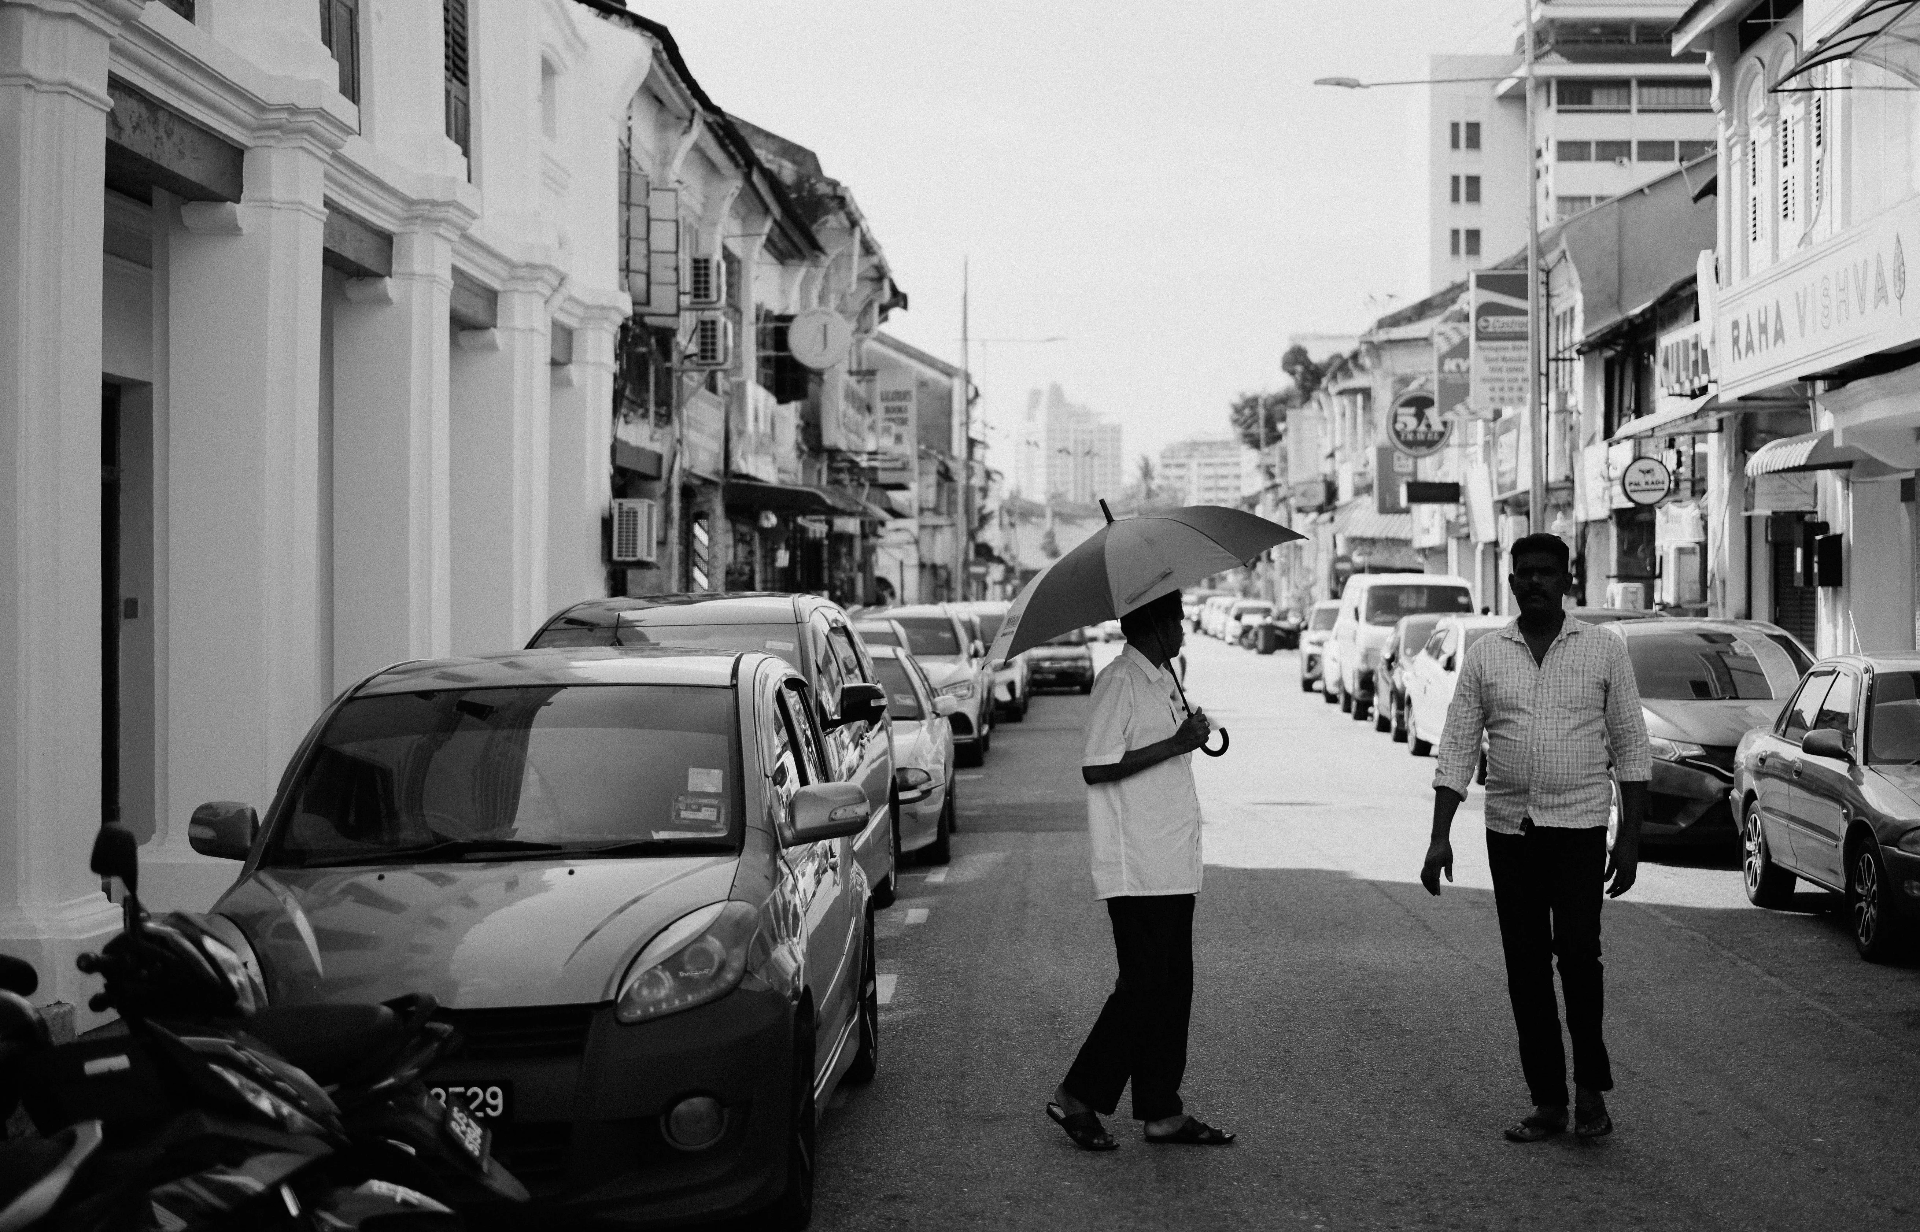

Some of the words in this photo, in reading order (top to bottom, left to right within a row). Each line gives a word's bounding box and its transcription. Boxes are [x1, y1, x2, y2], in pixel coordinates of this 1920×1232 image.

[1731, 299, 1786, 363] RAHA
[1795, 252, 1889, 339] VISHVA
[1394, 405, 1445, 432] 5A
